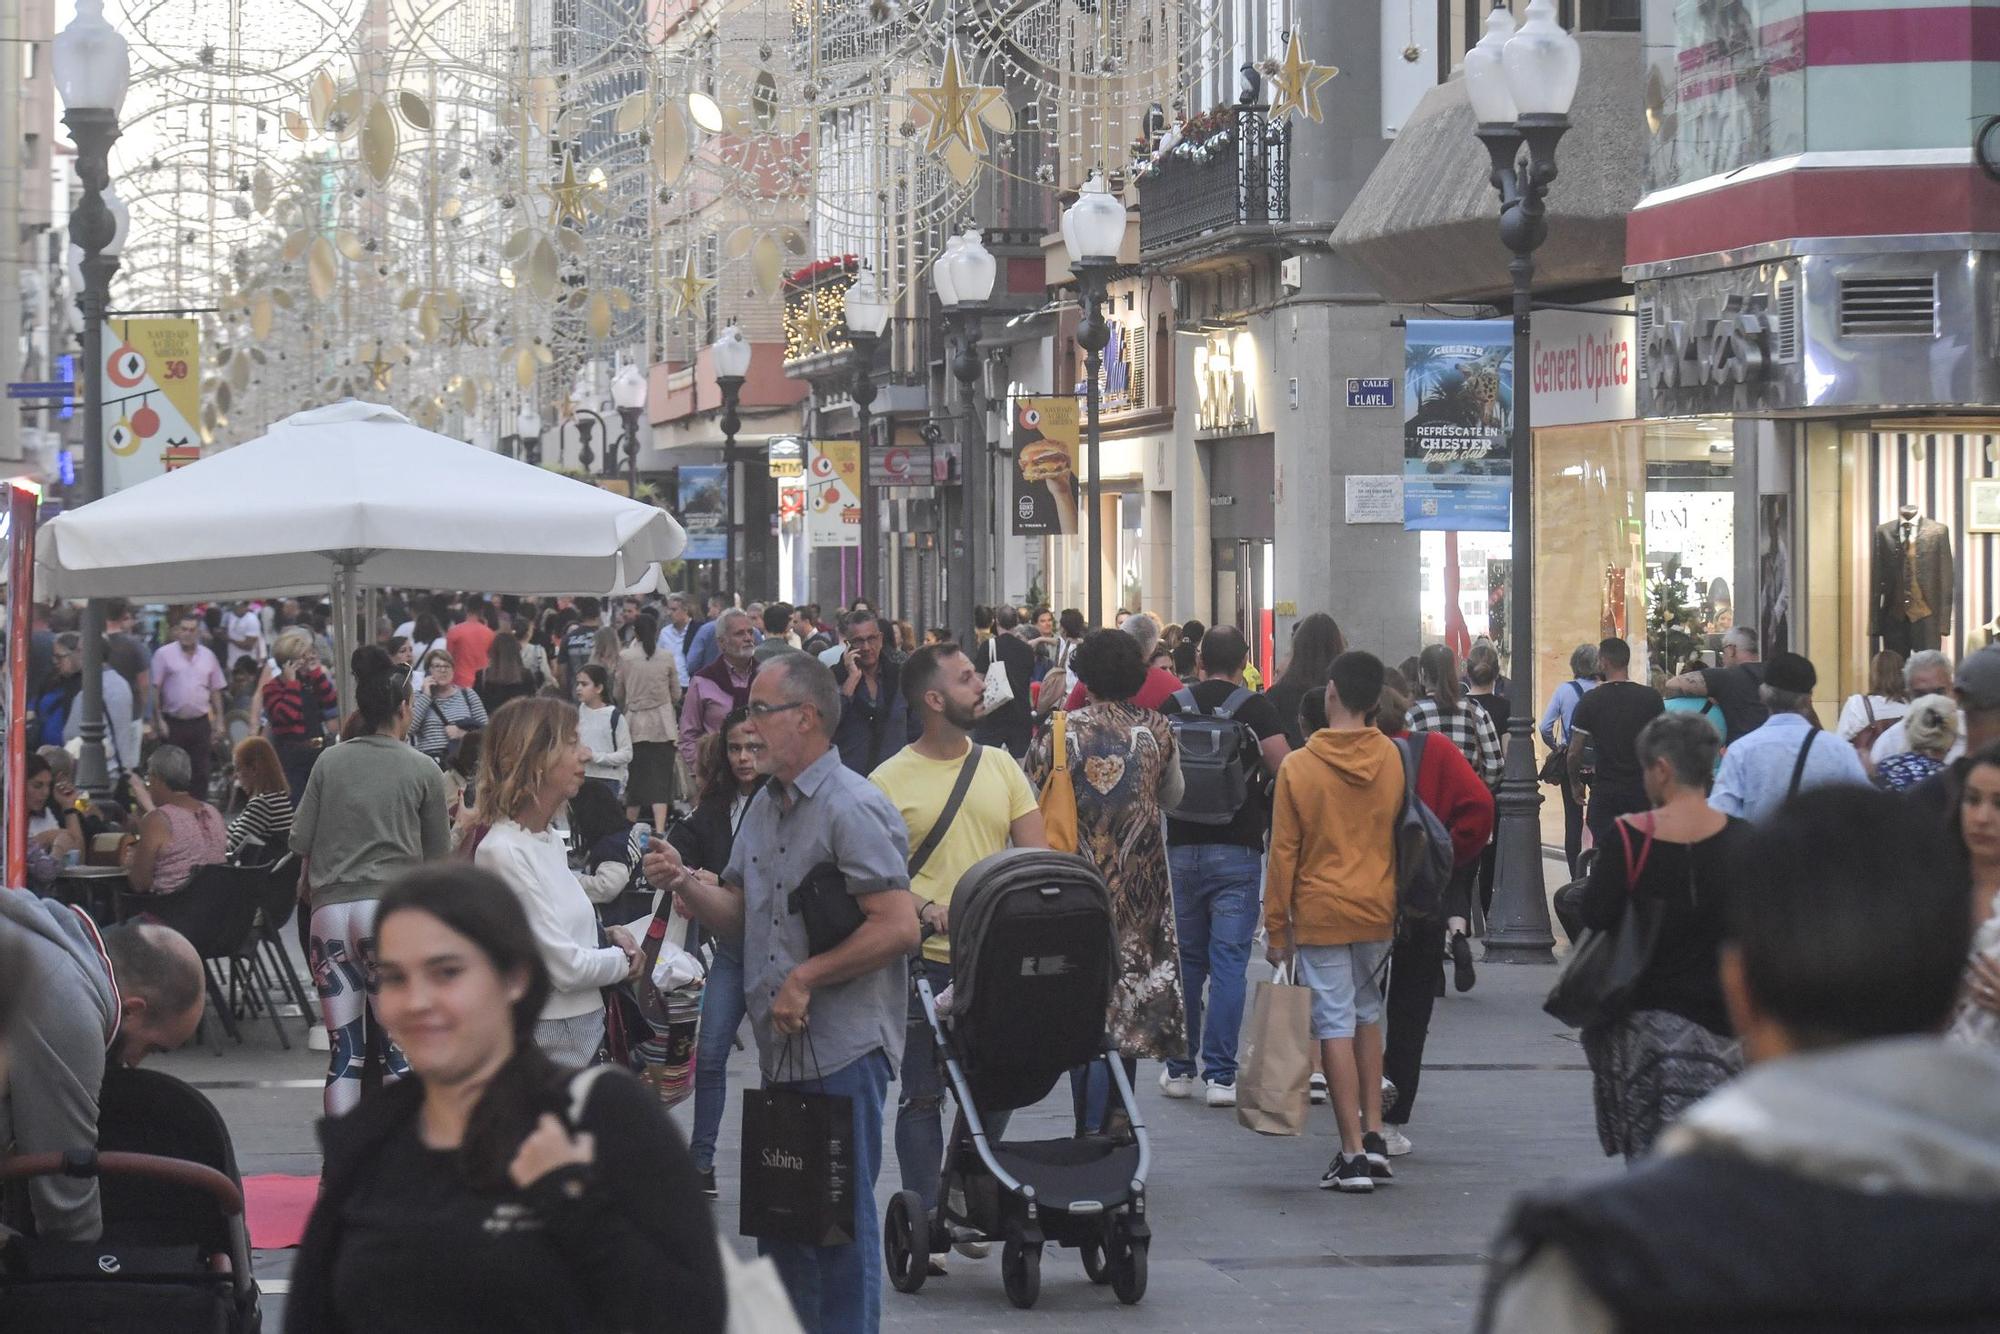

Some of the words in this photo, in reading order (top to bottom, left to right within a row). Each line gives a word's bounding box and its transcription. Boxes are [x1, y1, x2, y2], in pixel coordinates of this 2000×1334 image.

[1434, 345, 1484, 356] CHESTER
[163, 360, 188, 379] 30
[1533, 336, 1582, 395] General
[1585, 329, 1629, 405] Optica
[1362, 380, 1389, 388] CALLE
[1354, 394, 1387, 405] CLAVEL
[1416, 425, 1482, 436] REFRÉSCATE
[1484, 427, 1498, 436] EN
[1420, 438, 1492, 450] CHESTER
[1422, 448, 1459, 463] beach
[1460, 447, 1488, 460] club
[773, 462, 801, 473] ATM
[761, 1148, 804, 1171] Sabina
